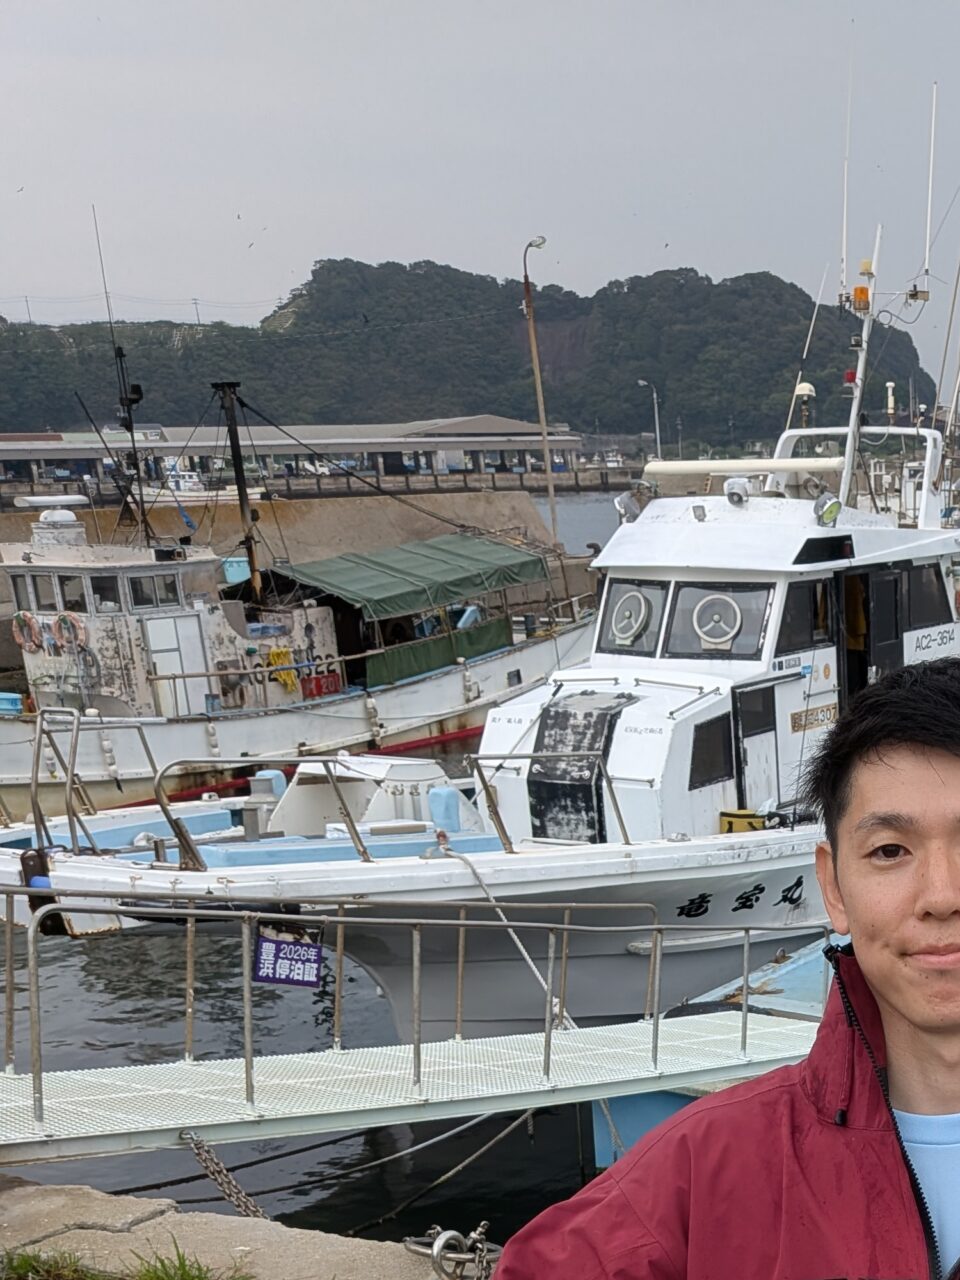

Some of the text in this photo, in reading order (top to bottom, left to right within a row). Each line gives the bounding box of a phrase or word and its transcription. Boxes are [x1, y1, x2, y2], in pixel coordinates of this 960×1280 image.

[914, 627, 955, 653] AC2-3614
[279, 943, 318, 962] 2026年
[275, 959, 319, 982] 停泊証
